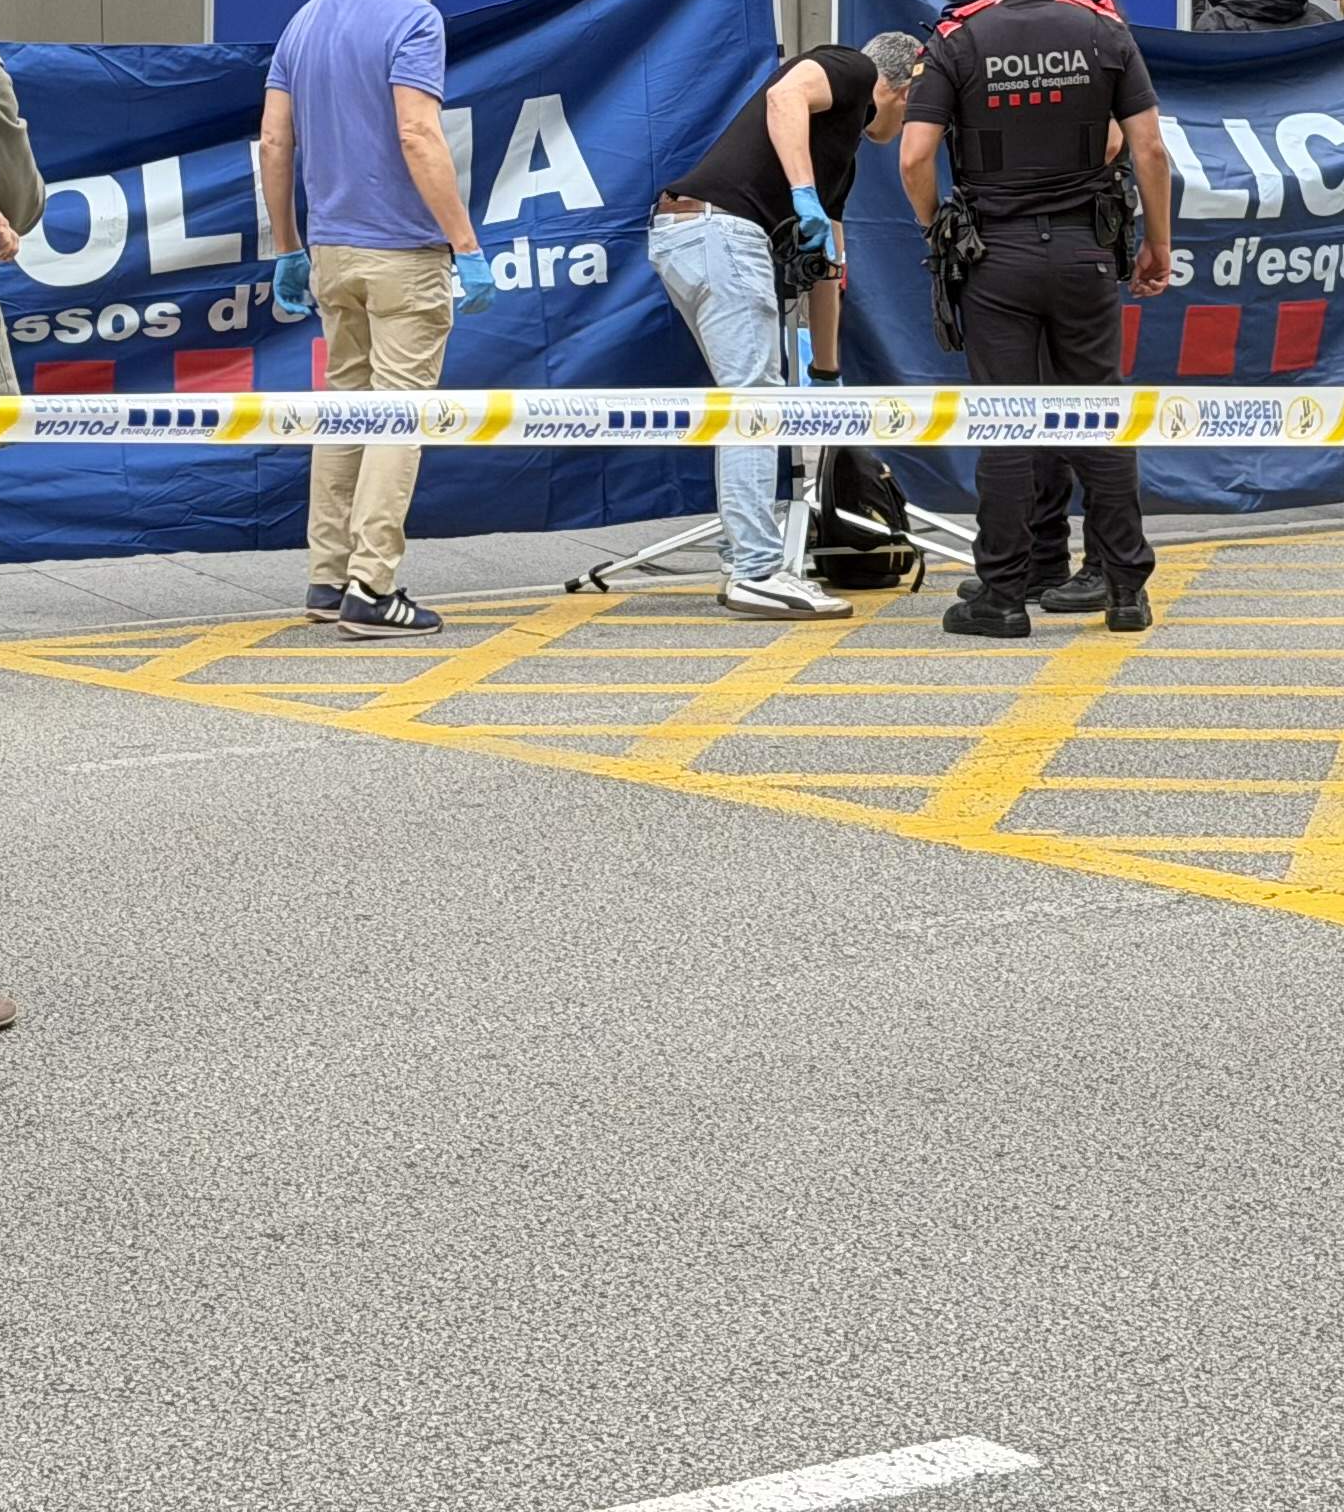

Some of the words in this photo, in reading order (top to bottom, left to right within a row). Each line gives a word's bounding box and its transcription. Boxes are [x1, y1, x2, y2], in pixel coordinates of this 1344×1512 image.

[985, 49, 1089, 79] POLICIA
[988, 79, 1030, 92] mossos
[1032, 73, 1090, 87] d'esquadra
[11, 302, 182, 344] ssos
[34, 419, 120, 436] POLICIA
[314, 417, 386, 435] PASSEU
[387, 417, 420, 435] NO
[523, 422, 601, 439] POLICIA
[776, 420, 843, 436] PASSEU
[846, 420, 870, 436] NO
[966, 422, 1038, 440] POLICIA
[1196, 420, 1255, 437] PASSEU
[1259, 420, 1284, 435] NO
